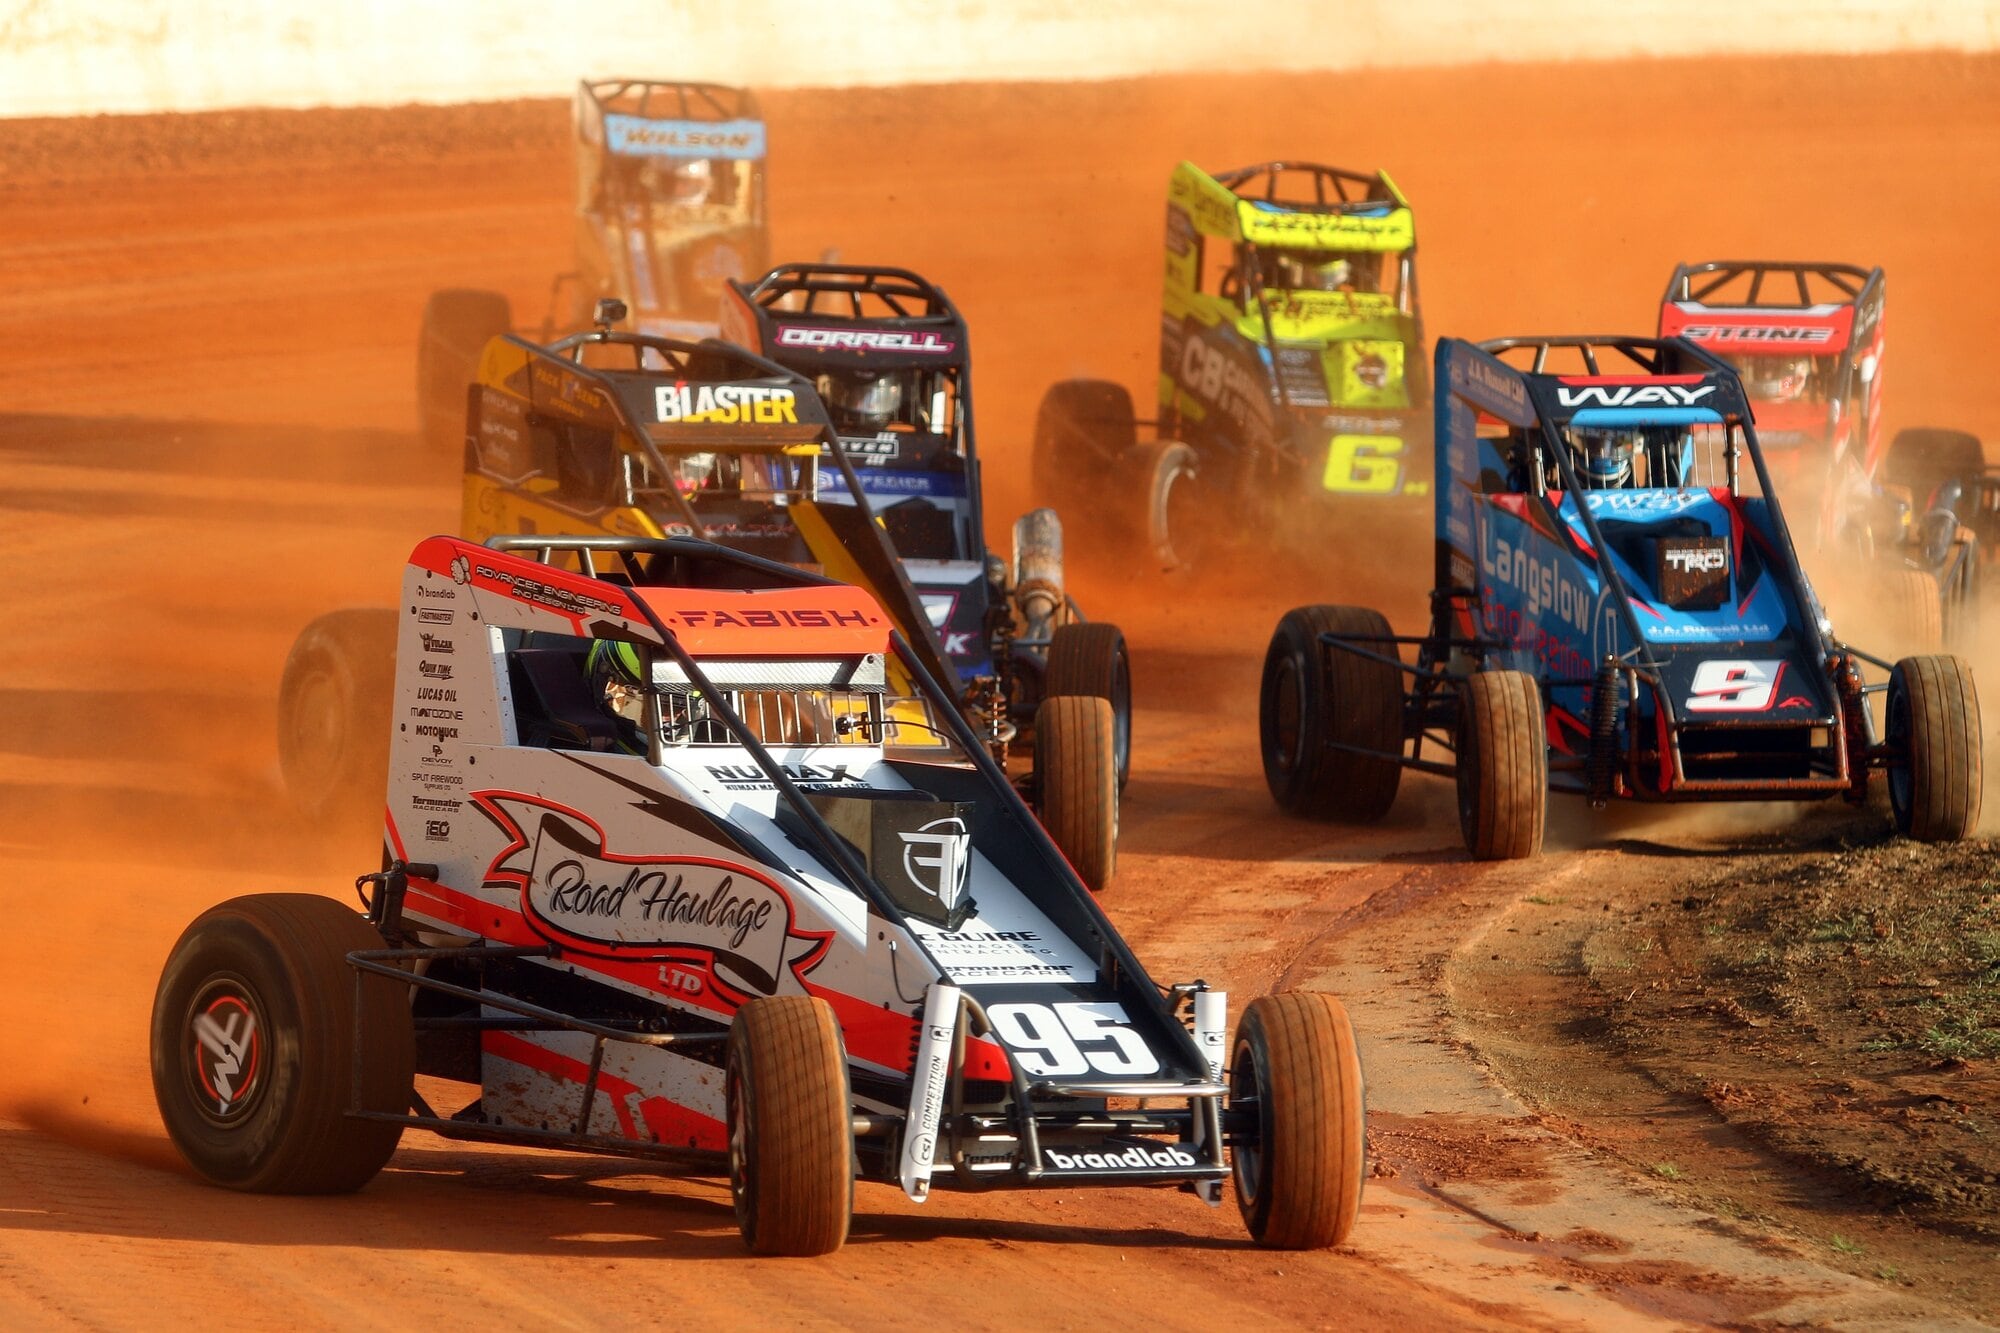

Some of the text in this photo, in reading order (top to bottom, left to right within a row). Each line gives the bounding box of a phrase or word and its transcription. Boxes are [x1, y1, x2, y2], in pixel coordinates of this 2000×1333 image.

[626, 128, 751, 150] WILSON
[779, 328, 952, 352] DORRELL
[1679, 324, 1835, 345] STONE
[655, 386, 799, 423] BLASTER
[1557, 386, 1716, 407] WAY
[1324, 435, 1403, 492] 6
[1481, 517, 1590, 635] Langslow
[425, 588, 456, 599] brandlab
[477, 566, 622, 615] ADVANCED ENGINEERING
[512, 588, 532, 600] AND
[532, 592, 567, 611] DESIGN
[676, 610, 871, 627] FABISH
[417, 687, 457, 702] LUCAS OIL
[430, 774, 463, 785] FIREWOOD
[412, 795, 463, 808] Terminator
[412, 805, 460, 813] RACECARS
[545, 859, 772, 949] Road Haulage
[943, 964, 1074, 972] erminator
[658, 965, 702, 995] LTD
[987, 1003, 1159, 1075] 95
[923, 1055, 941, 1130] COMPETITION
[1045, 1147, 1196, 1169] brandlab
